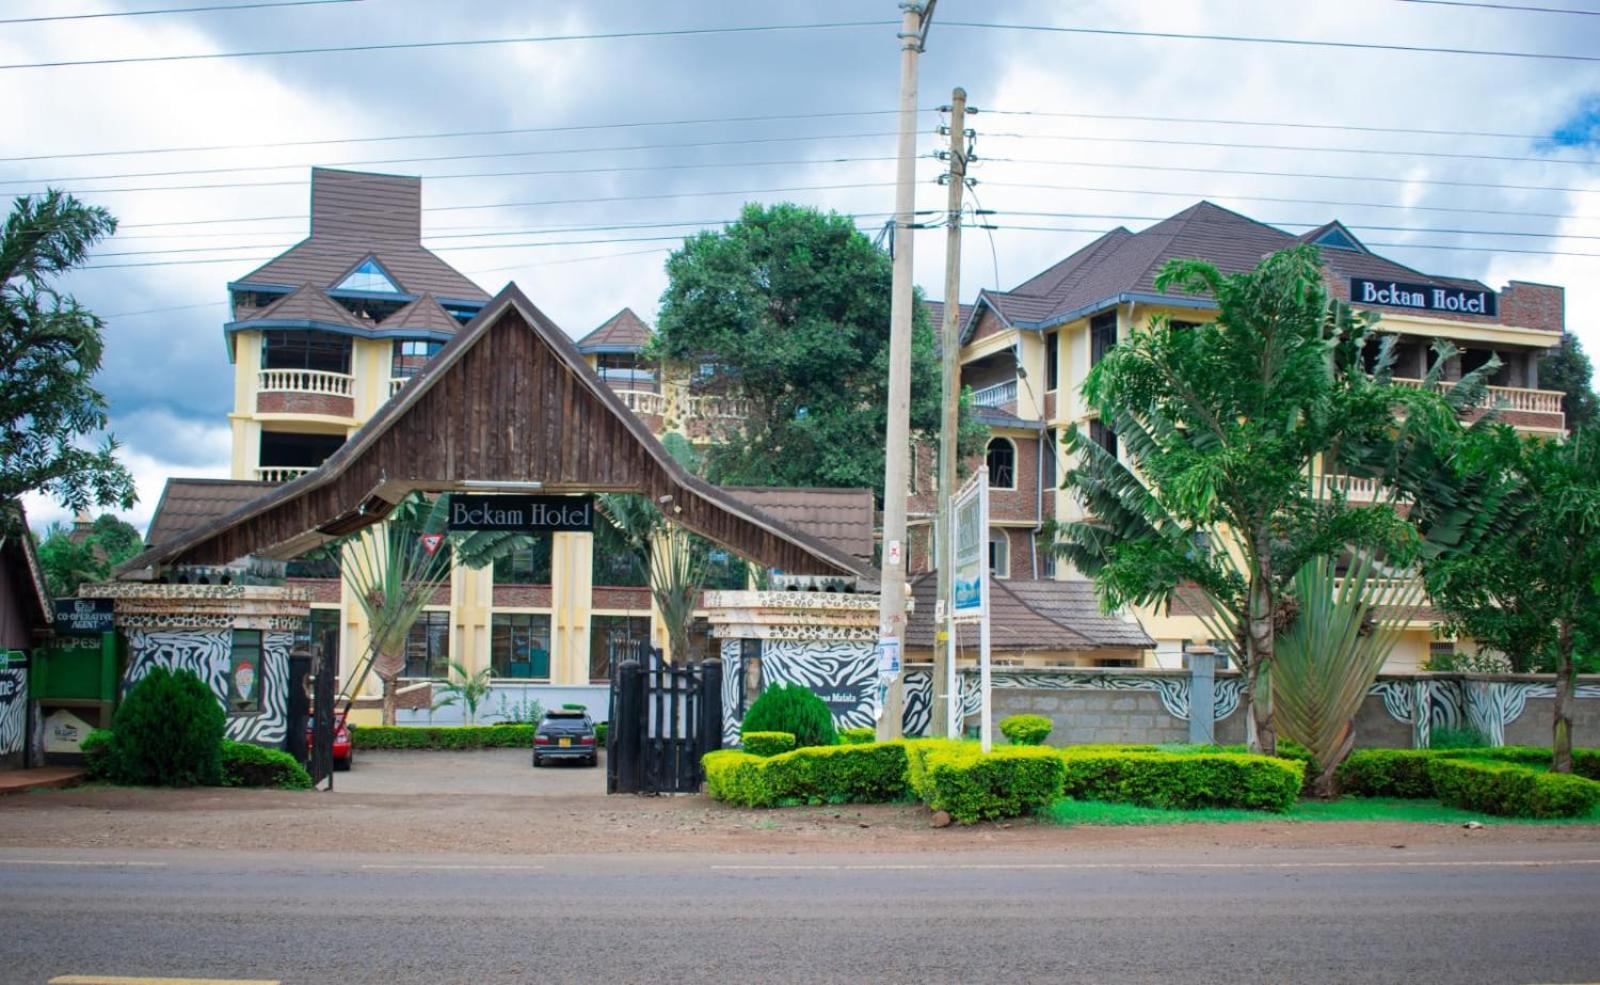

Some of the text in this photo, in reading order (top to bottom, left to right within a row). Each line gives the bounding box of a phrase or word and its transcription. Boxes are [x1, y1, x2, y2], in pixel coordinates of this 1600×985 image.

[1362, 281, 1486, 314] Bekam Hotel
[453, 502, 590, 526] Bekam Hotel
[71, 621, 98, 629] AGENT
